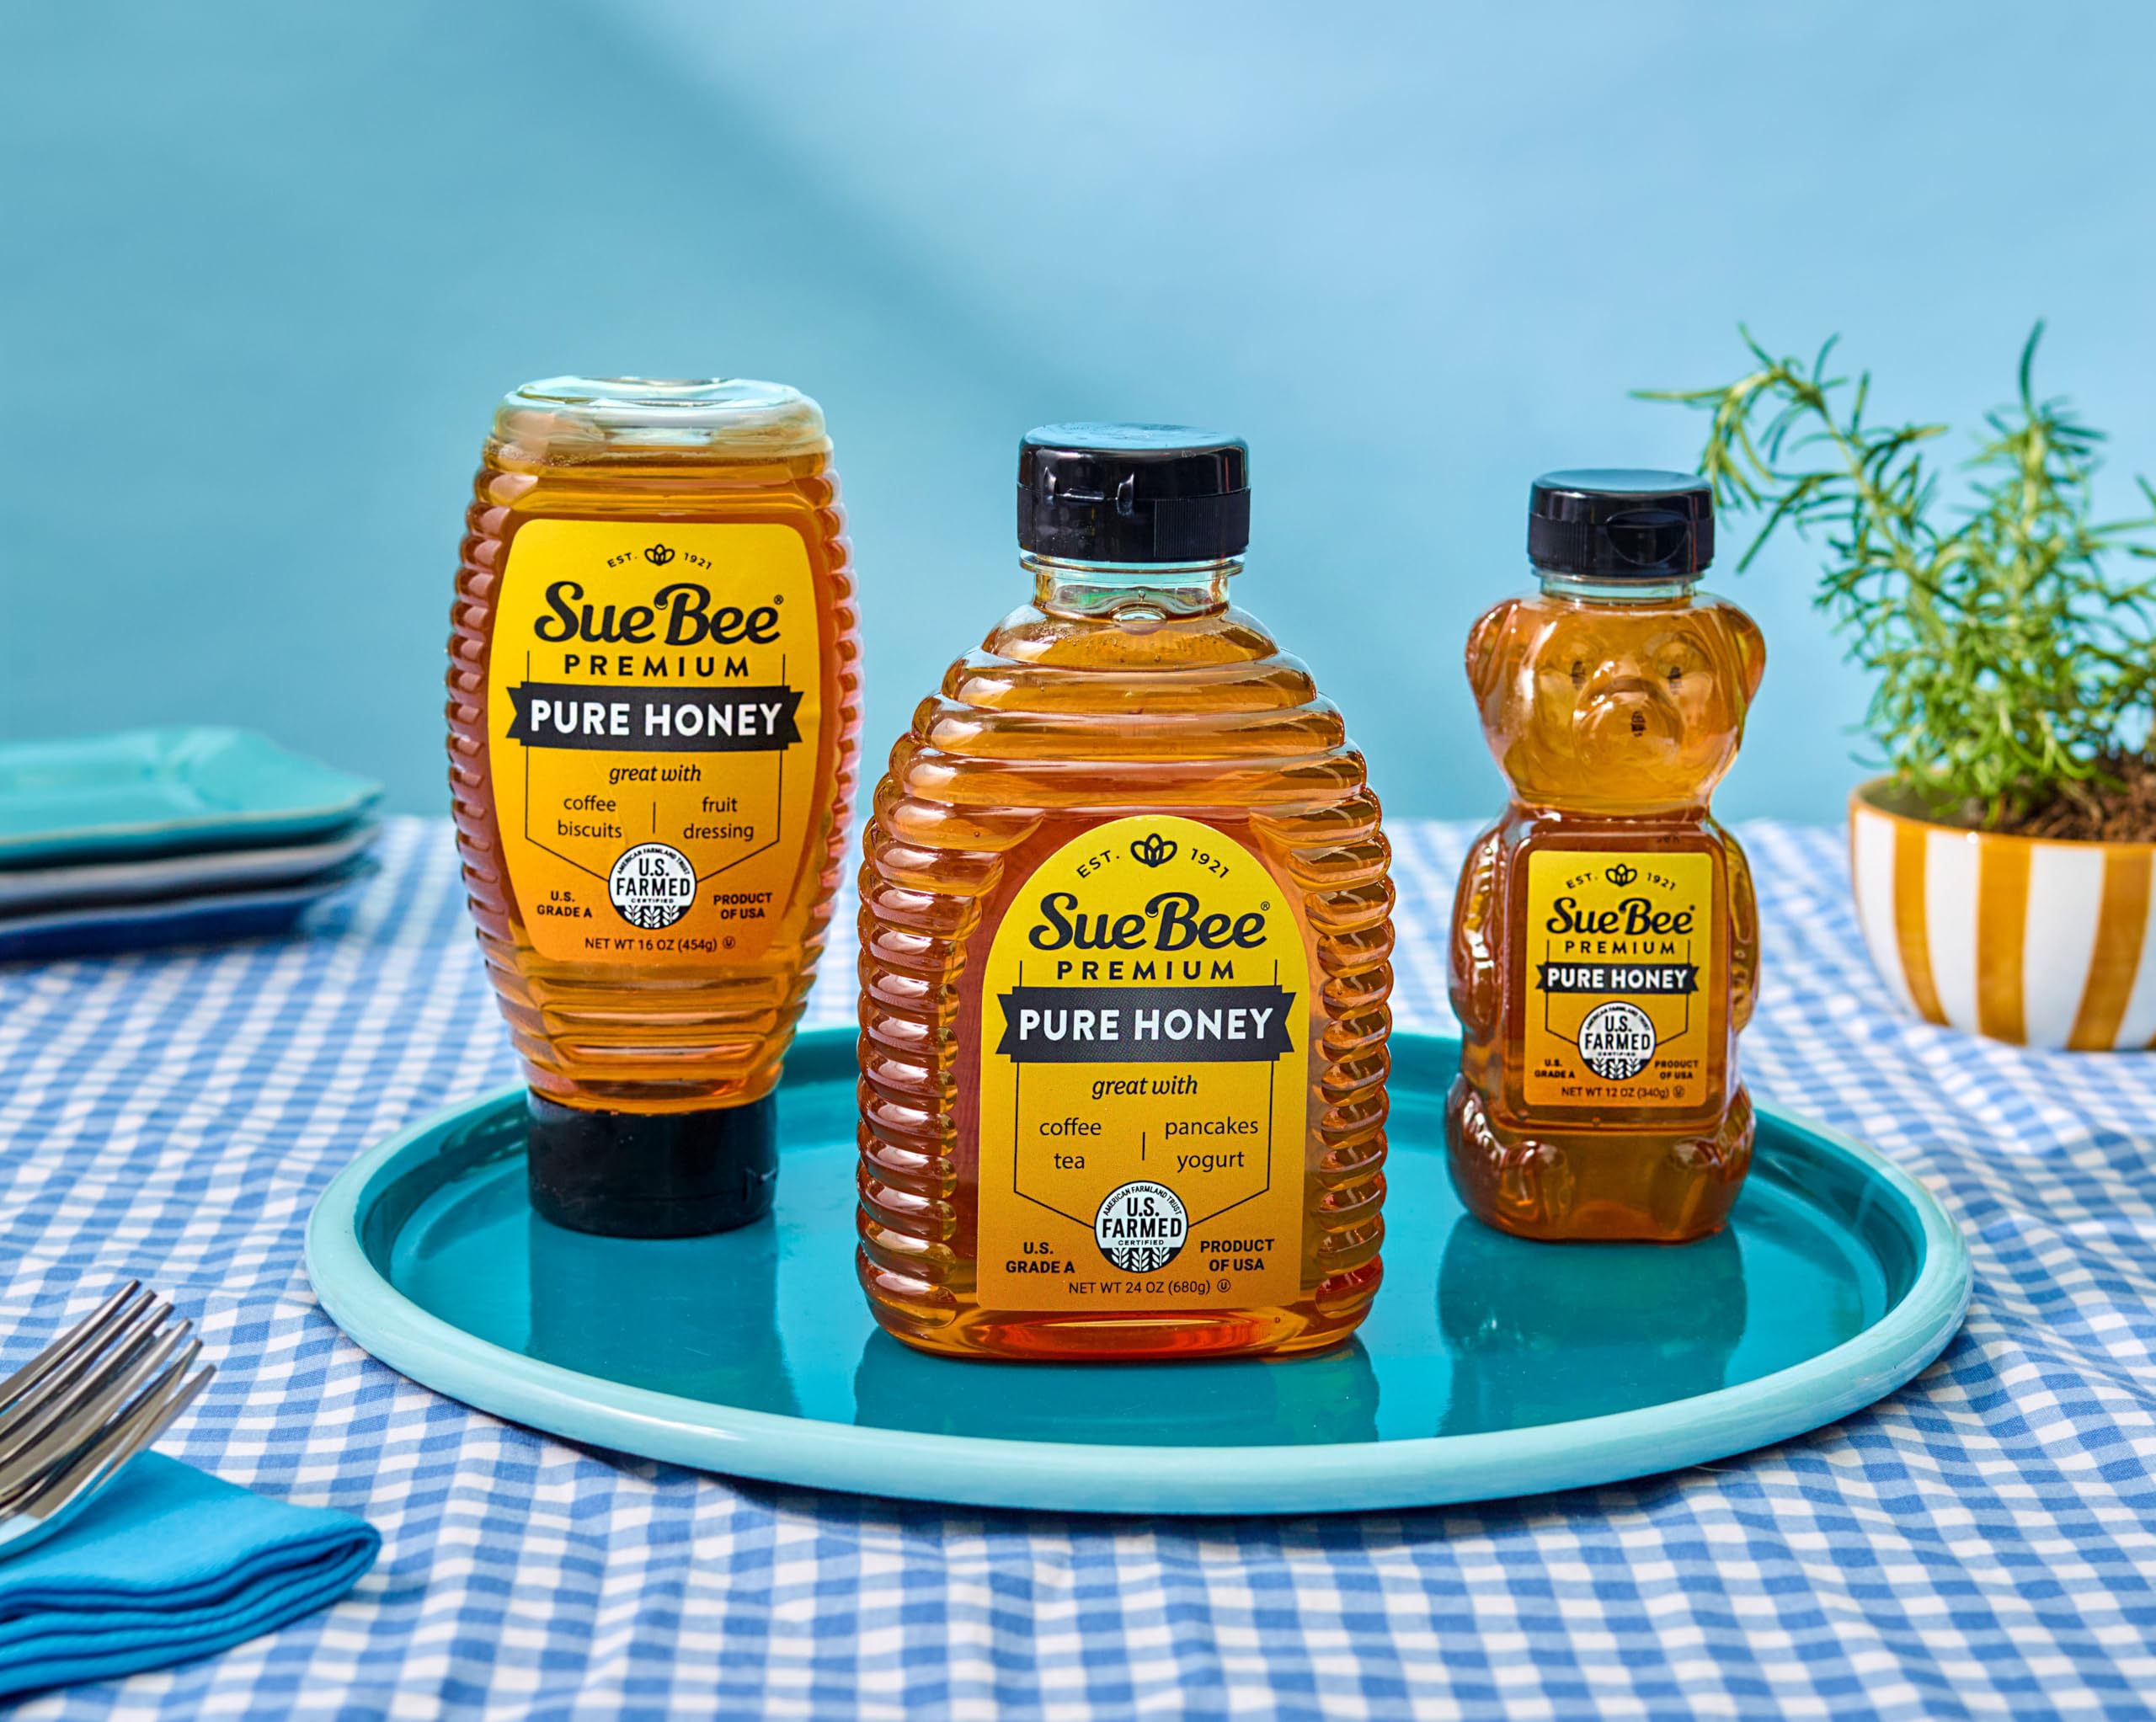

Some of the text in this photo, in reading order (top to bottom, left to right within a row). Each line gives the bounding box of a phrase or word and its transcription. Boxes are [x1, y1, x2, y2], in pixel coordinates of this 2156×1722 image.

[606, 552, 712, 570] EST. 1921
[564, 653, 749, 677] PREMIUM
[531, 699, 783, 737] PURE HONEY
[608, 764, 702, 784] great with
[563, 795, 616, 812] coffee
[702, 796, 738, 813] fruit
[557, 819, 622, 839] biscuits
[683, 821, 754, 841] dressing
[638, 858, 670, 877] U.S.
[1076, 847, 1230, 879] EST. 1921
[616, 877, 691, 897] FARMED
[1566, 872, 1677, 891] EST. 1921
[550, 891, 576, 903] U.S.
[713, 892, 773, 905] PRODUCT
[536, 905, 593, 918] GRADE A
[720, 908, 766, 920] OF USA
[584, 936, 611, 950] NET
[614, 937, 635, 950] WT
[638, 938, 654, 951] 16
[656, 938, 675, 951] OZ
[677, 937, 718, 952] (454g)
[1565, 941, 1675, 954] PREMIUM
[1056, 960, 1235, 980] PREMIUM
[1547, 968, 1688, 989] PURE HONEY
[1018, 1007, 1274, 1042] PURE HONEY
[1604, 1016, 1632, 1032] U.S.
[1585, 1033, 1651, 1050] FARMED
[1654, 1059, 1699, 1069] PRODUCT
[1534, 1069, 1576, 1079] GRADE A
[1659, 1071, 1693, 1080] OF USA
[1091, 1074, 1198, 1100] great with
[1561, 1086, 1582, 1096] NET
[1585, 1086, 1604, 1097] WT
[1605, 1086, 1617, 1097] 12
[1620, 1087, 1636, 1097] OZ
[1039, 1117, 1102, 1137] coffee
[1165, 1116, 1260, 1138] pancakes
[1054, 1151, 1086, 1170] tea
[1177, 1150, 1246, 1173] yogurt
[1102, 1185, 1182, 1217] AMERICAN FARMLAND TRUST
[1127, 1197, 1160, 1218] U.S.
[1102, 1218, 1182, 1239] FARMED
[1022, 1240, 1054, 1256] U.S.
[1199, 1239, 1276, 1254] PRODUCT
[1005, 1260, 1075, 1275] GRADE A
[1208, 1256, 1266, 1272] OF USA
[1068, 1282, 1096, 1295] NET
[1098, 1282, 1123, 1295] WT
[1125, 1281, 1143, 1294] 24
[1145, 1281, 1166, 1294] OZ
[1167, 1279, 1211, 1296] (680g)
